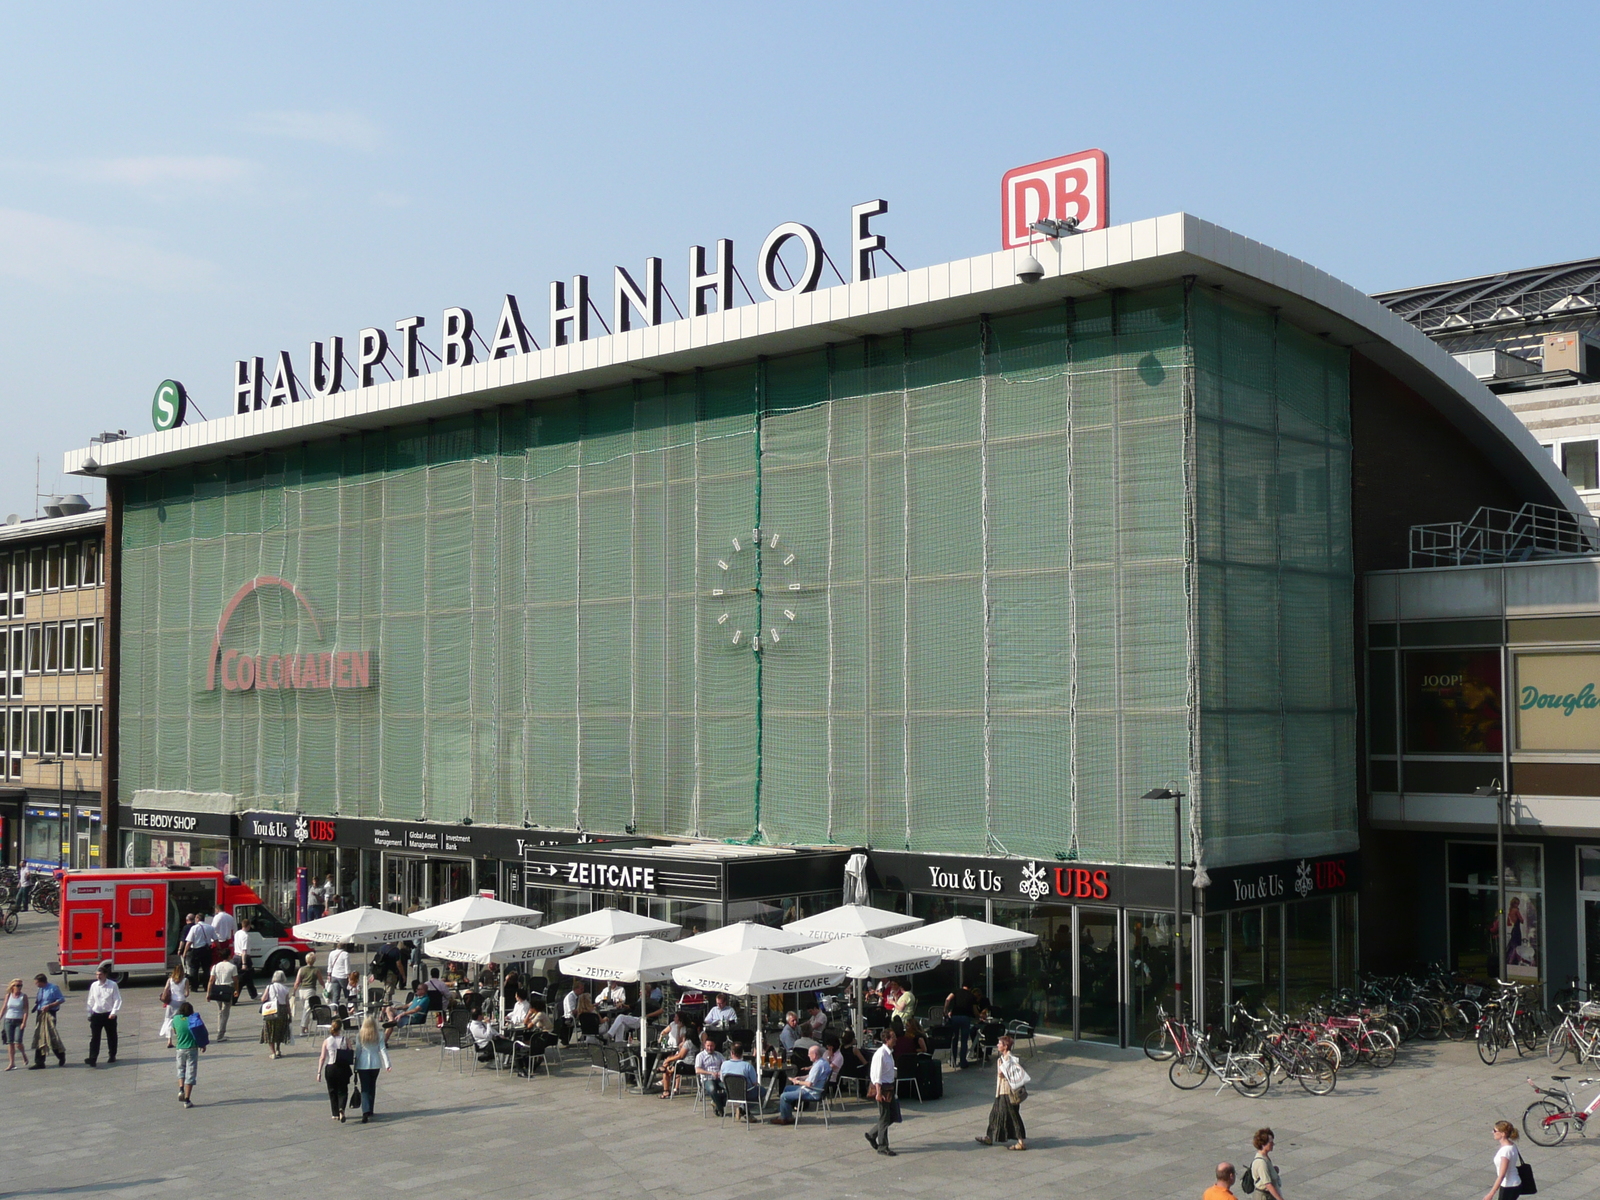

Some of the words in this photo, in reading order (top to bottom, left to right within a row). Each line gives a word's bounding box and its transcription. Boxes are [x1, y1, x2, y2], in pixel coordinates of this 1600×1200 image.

[1014, 167, 1090, 239] DB
[234, 198, 888, 416] HAUPTBAHNHOF
[157, 386, 174, 428] S
[221, 648, 370, 691] COLONADEN
[1420, 674, 1464, 687] JOOP!
[1519, 682, 1600, 717] Dougla
[133, 812, 149, 827] THE
[150, 814, 173, 829] BODY
[173, 816, 197, 830] SHOP
[252, 820, 268, 836] You
[268, 821, 276, 837] &
[276, 822, 287, 838] Us
[309, 820, 335, 842] UBS
[374, 828, 390, 837] Wealth
[409, 831, 424, 840] Global
[424, 832, 437, 840] Asset
[445, 833, 471, 843] Investment
[374, 837, 403, 848] Management
[409, 840, 439, 850] Management
[445, 842, 458, 851] Bank
[568, 862, 655, 890] ZEITCAFE
[929, 865, 960, 889] You
[962, 867, 977, 890] &
[978, 868, 1002, 892] Us
[1053, 866, 1109, 900] UBS
[1315, 859, 1347, 890] UBS
[1232, 878, 1256, 902] You
[1257, 875, 1268, 899] &
[1268, 873, 1284, 896] Us
[382, 929, 425, 941] ZEITCAFE
[521, 945, 565, 959] ZEITCAFE
[894, 959, 931, 974] ZEITCAFE
[782, 976, 831, 991] ZEITCAFE
